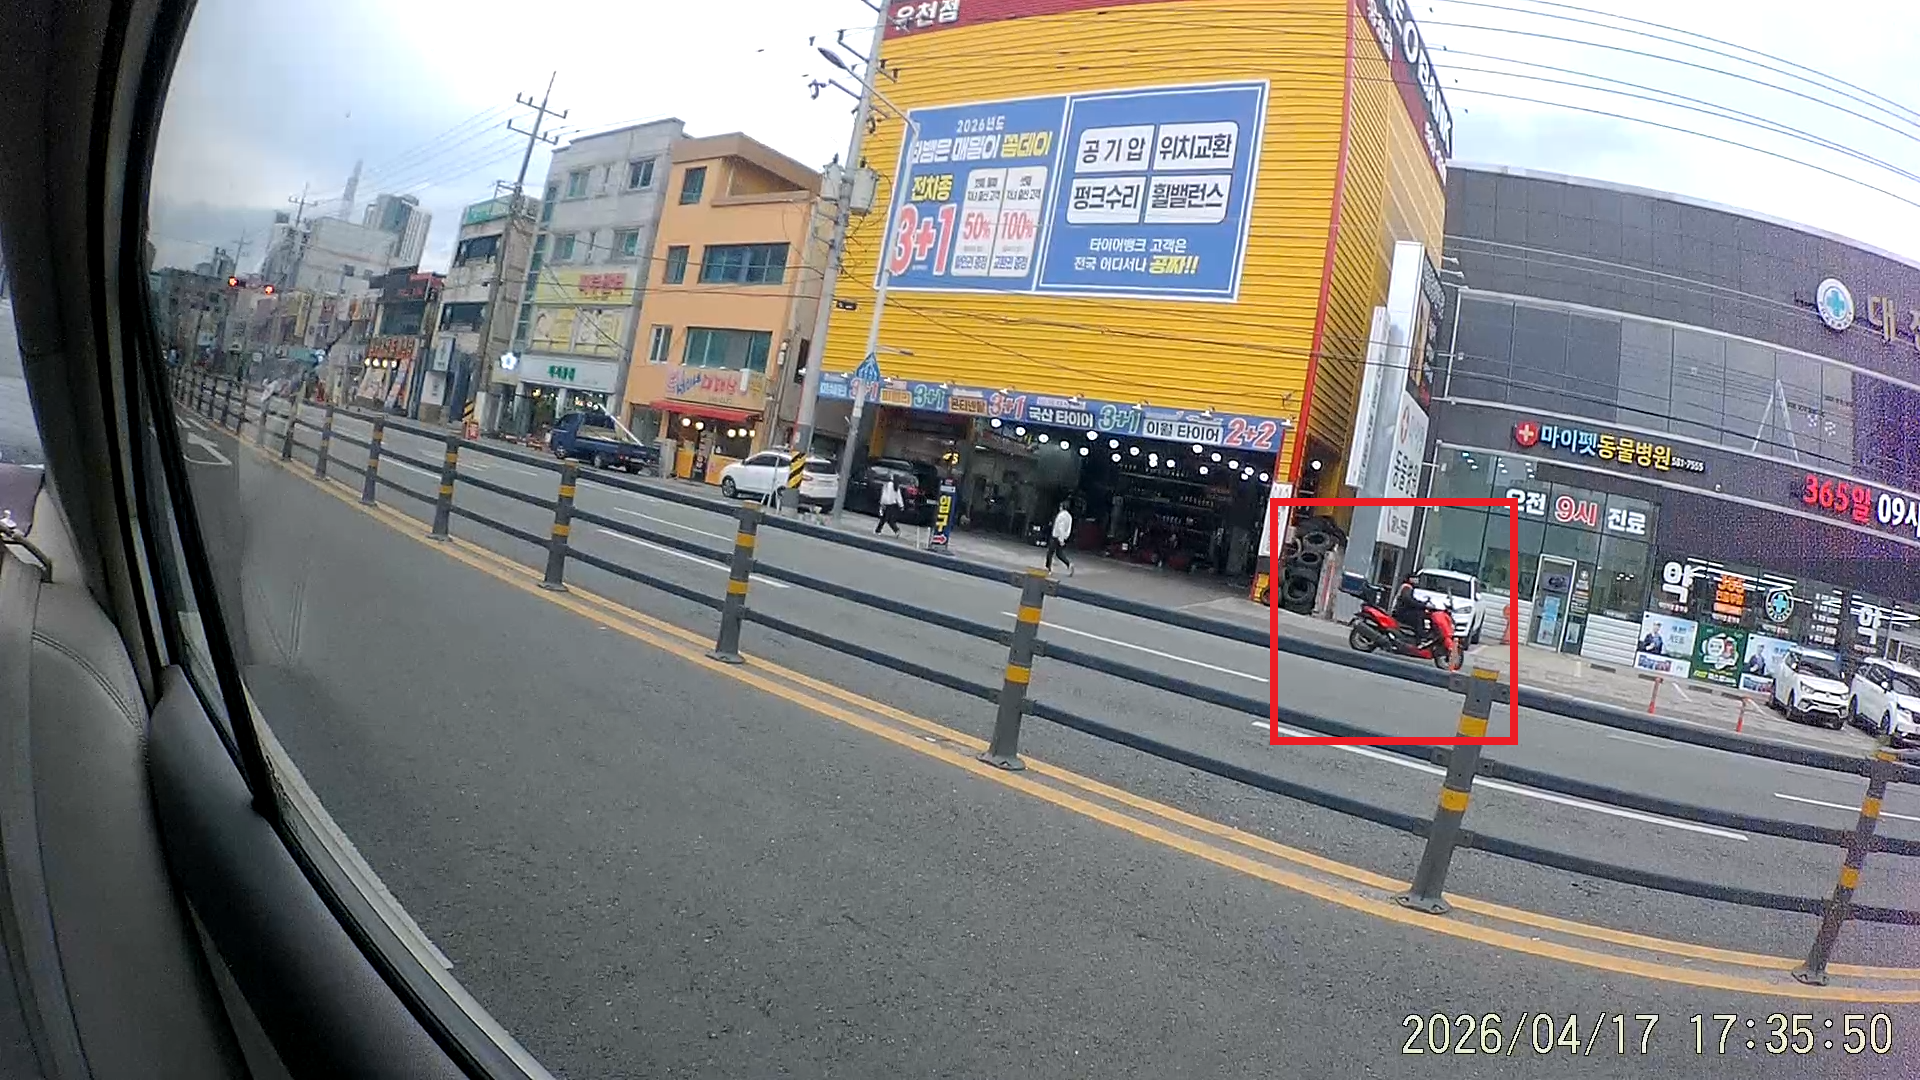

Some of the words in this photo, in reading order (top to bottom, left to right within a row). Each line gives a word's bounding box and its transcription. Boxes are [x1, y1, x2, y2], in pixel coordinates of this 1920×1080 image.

[956, 115, 1006, 133] 2026년도
[1159, 133, 1232, 160] 위치교환
[911, 174, 954, 202] 전차종
[1074, 184, 1140, 210] 펑크수리
[1151, 183, 1224, 209] 휠밸런스
[889, 203, 957, 276] 3+1
[963, 212, 991, 240] 50%
[1002, 212, 1034, 240] 100%
[1089, 238, 1147, 253] 타이어뱅크
[1149, 238, 1187, 253] 고객은
[1074, 256, 1097, 271] 전국
[1100, 256, 1147, 272] 어디서나
[1149, 255, 1199, 274] 공짜!!
[914, 383, 945, 411] 3+1
[988, 392, 1027, 420] 3+1
[1029, 406, 1054, 422] 국산
[1055, 411, 1094, 428] 타이어
[1099, 404, 1141, 434] 3+1
[1147, 421, 1173, 437] 이월
[1177, 425, 1220, 442] 타이어
[1223, 417, 1277, 449] 2+2
[1504, 488, 1547, 517] 오전
[1554, 494, 1598, 527] 9시
[1607, 507, 1646, 535] 진료
[1802, 473, 1872, 525] 365일
[1661, 561, 1694, 604] 약
